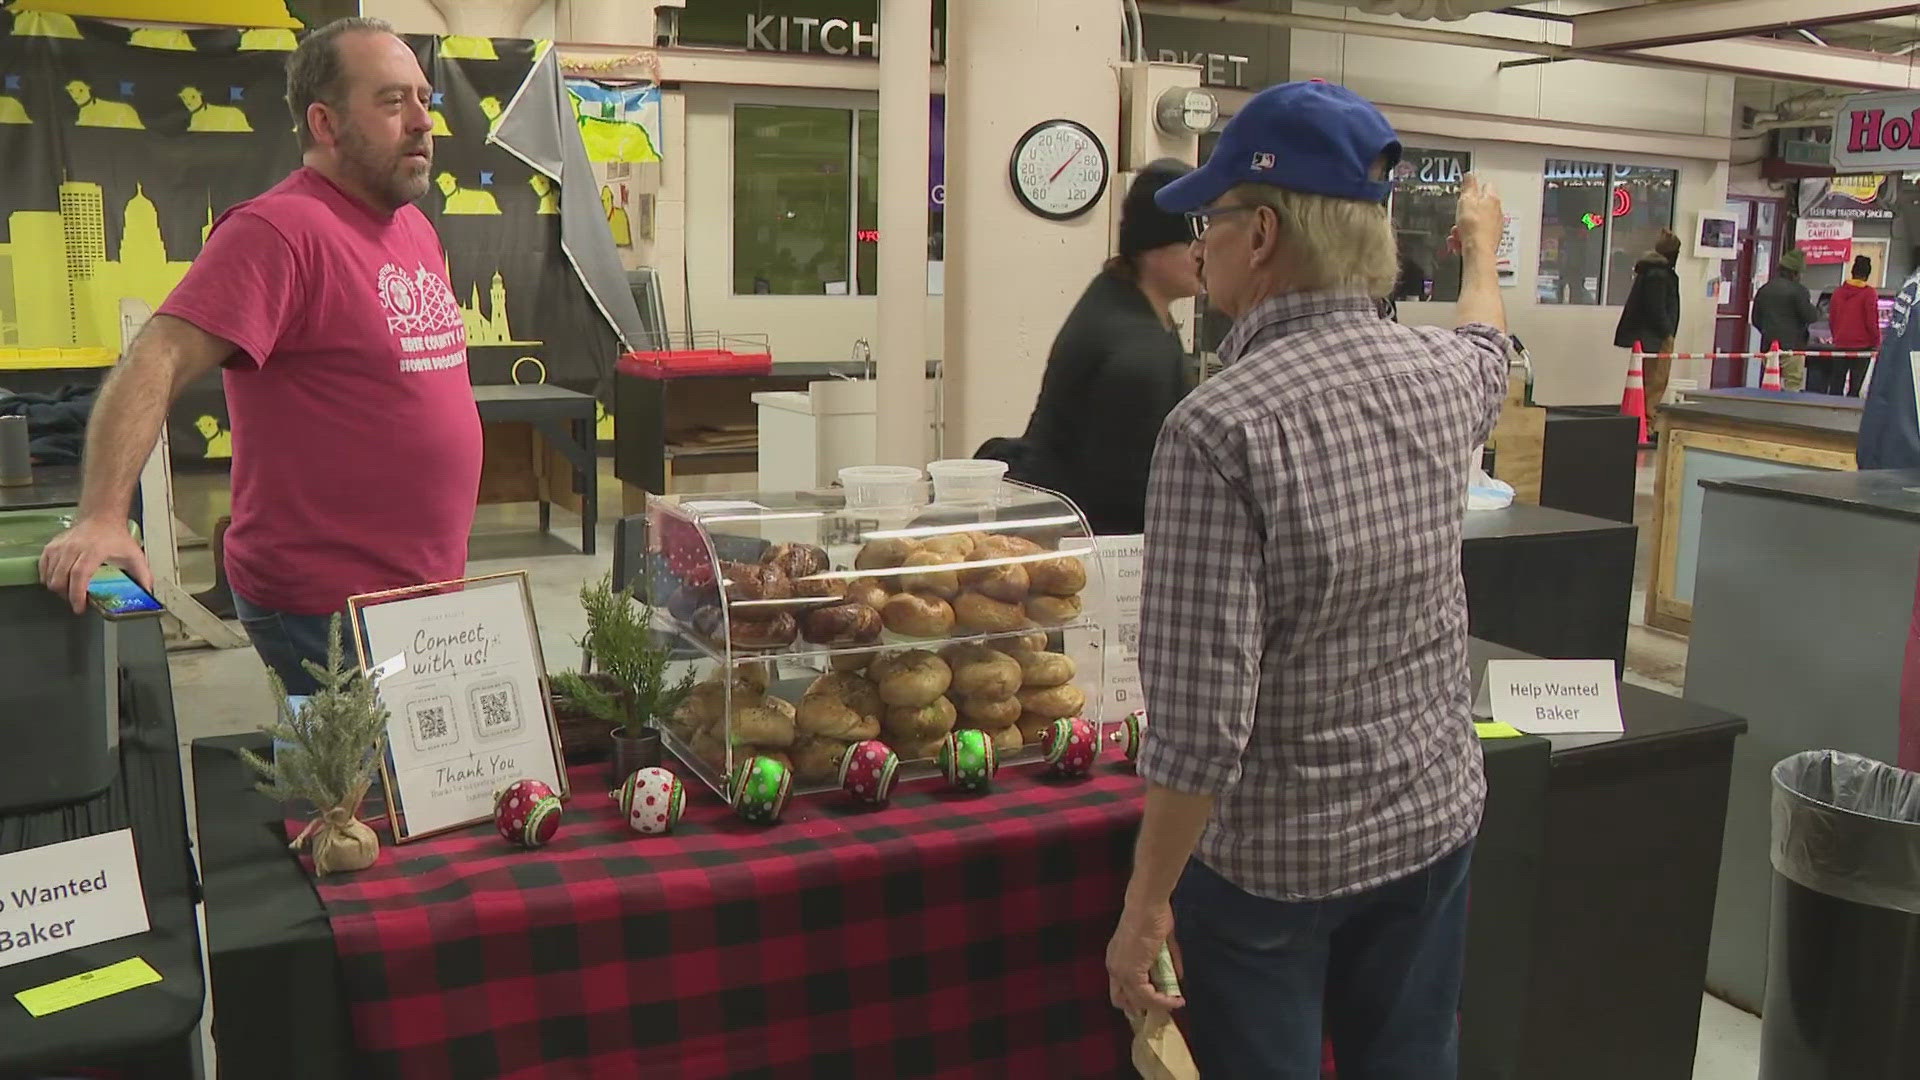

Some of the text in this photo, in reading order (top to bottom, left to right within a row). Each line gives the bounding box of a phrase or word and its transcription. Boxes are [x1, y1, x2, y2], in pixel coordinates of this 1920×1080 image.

[746, 13, 940, 61] KITCH
[1038, 135, 1053, 147] 20
[1021, 163, 1035, 174] 20
[1083, 155, 1098, 166] 80
[1082, 170, 1101, 182] 100
[1032, 188, 1047, 200] 60
[1067, 189, 1087, 200] 120
[414, 623, 485, 655] Connect
[413, 638, 490, 675] with us!
[1510, 683, 1599, 699] Help Wanted
[1535, 705, 1580, 721] Baker
[436, 754, 515, 788] Thank You
[11, 869, 108, 909] Wanted
[0, 918, 76, 952] Baker
